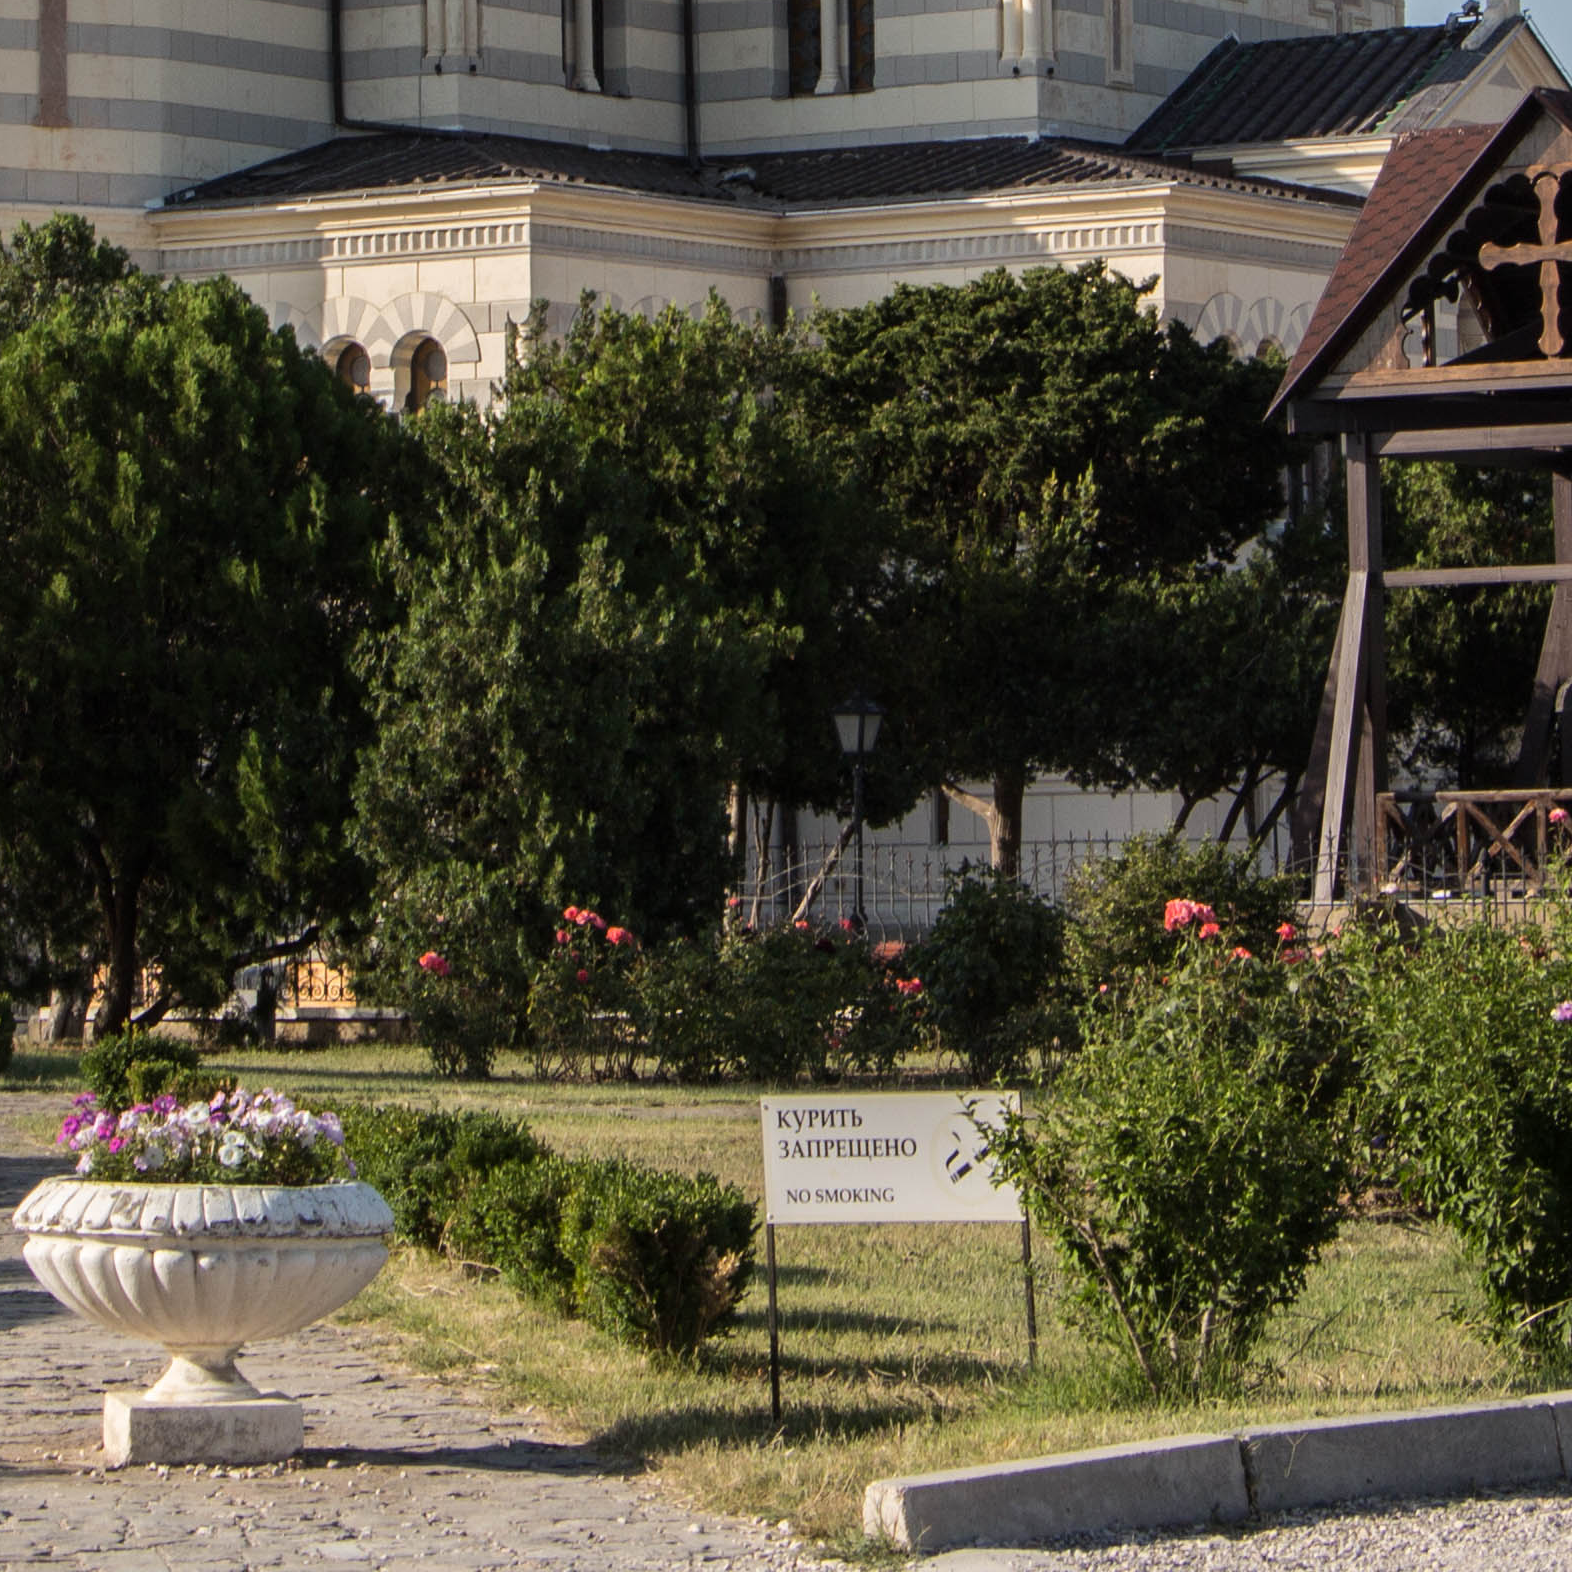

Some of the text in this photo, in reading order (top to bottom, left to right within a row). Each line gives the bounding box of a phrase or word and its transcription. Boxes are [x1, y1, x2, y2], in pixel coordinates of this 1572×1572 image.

[777, 1109, 863, 1134] КУРИТЬ
[778, 1137, 917, 1161] ЗАПРЕЩЕНО
[786, 1188, 895, 1204] NO SMOKING
